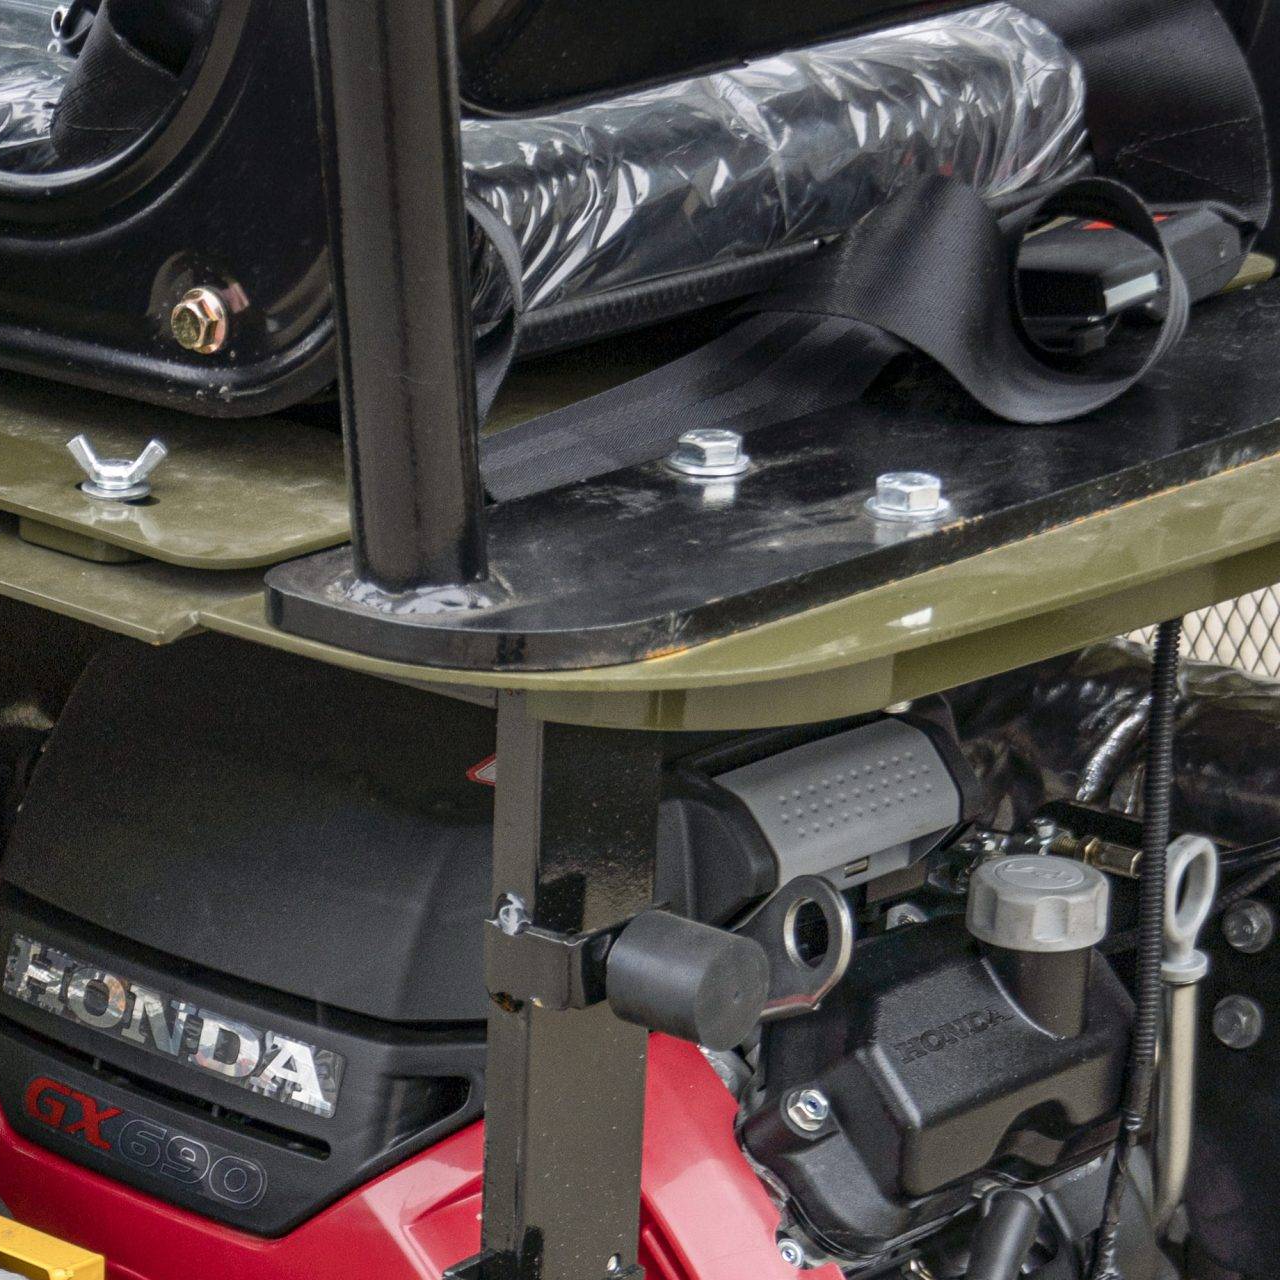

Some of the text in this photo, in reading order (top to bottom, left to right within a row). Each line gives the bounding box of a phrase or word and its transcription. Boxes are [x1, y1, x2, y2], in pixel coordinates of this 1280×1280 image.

[6, 936, 335, 1116] HONDA
[893, 1005, 1014, 1065] HONDA
[25, 1076, 268, 1208] GX690
